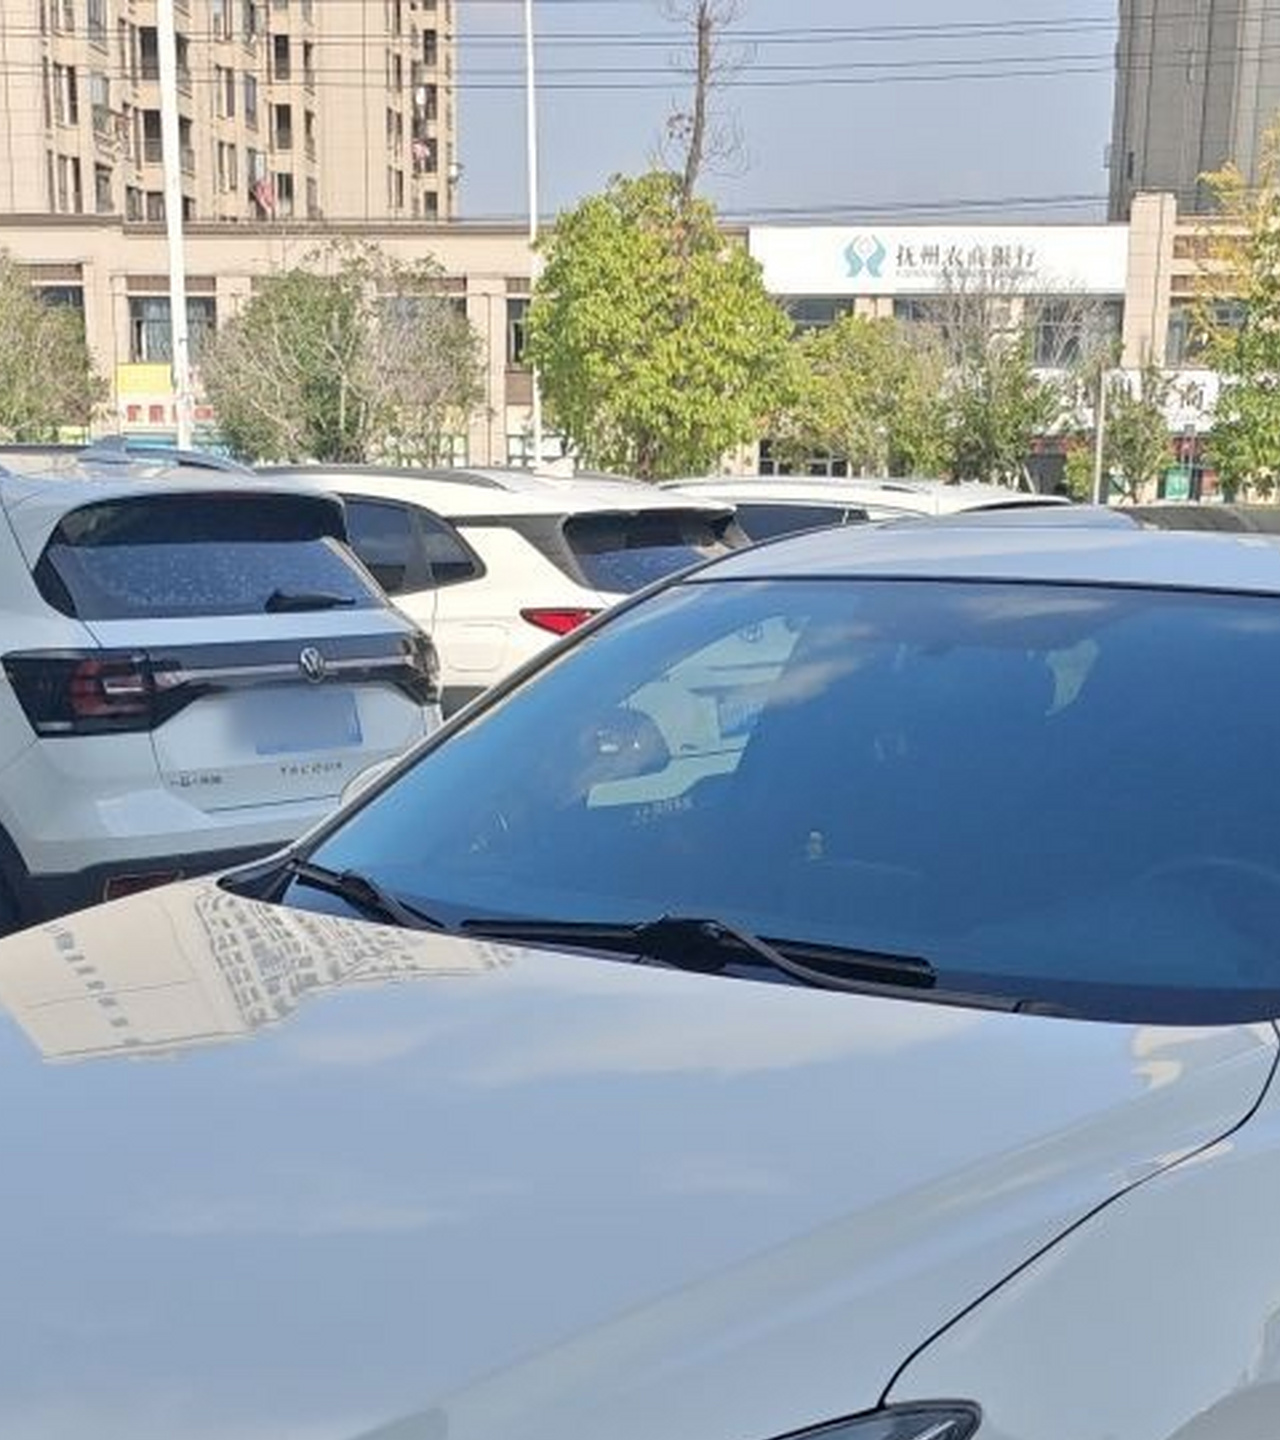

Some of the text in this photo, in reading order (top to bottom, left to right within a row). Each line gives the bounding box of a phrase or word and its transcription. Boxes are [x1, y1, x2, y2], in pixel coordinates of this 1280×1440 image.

[896, 243, 1036, 268] 抚州农商银行
